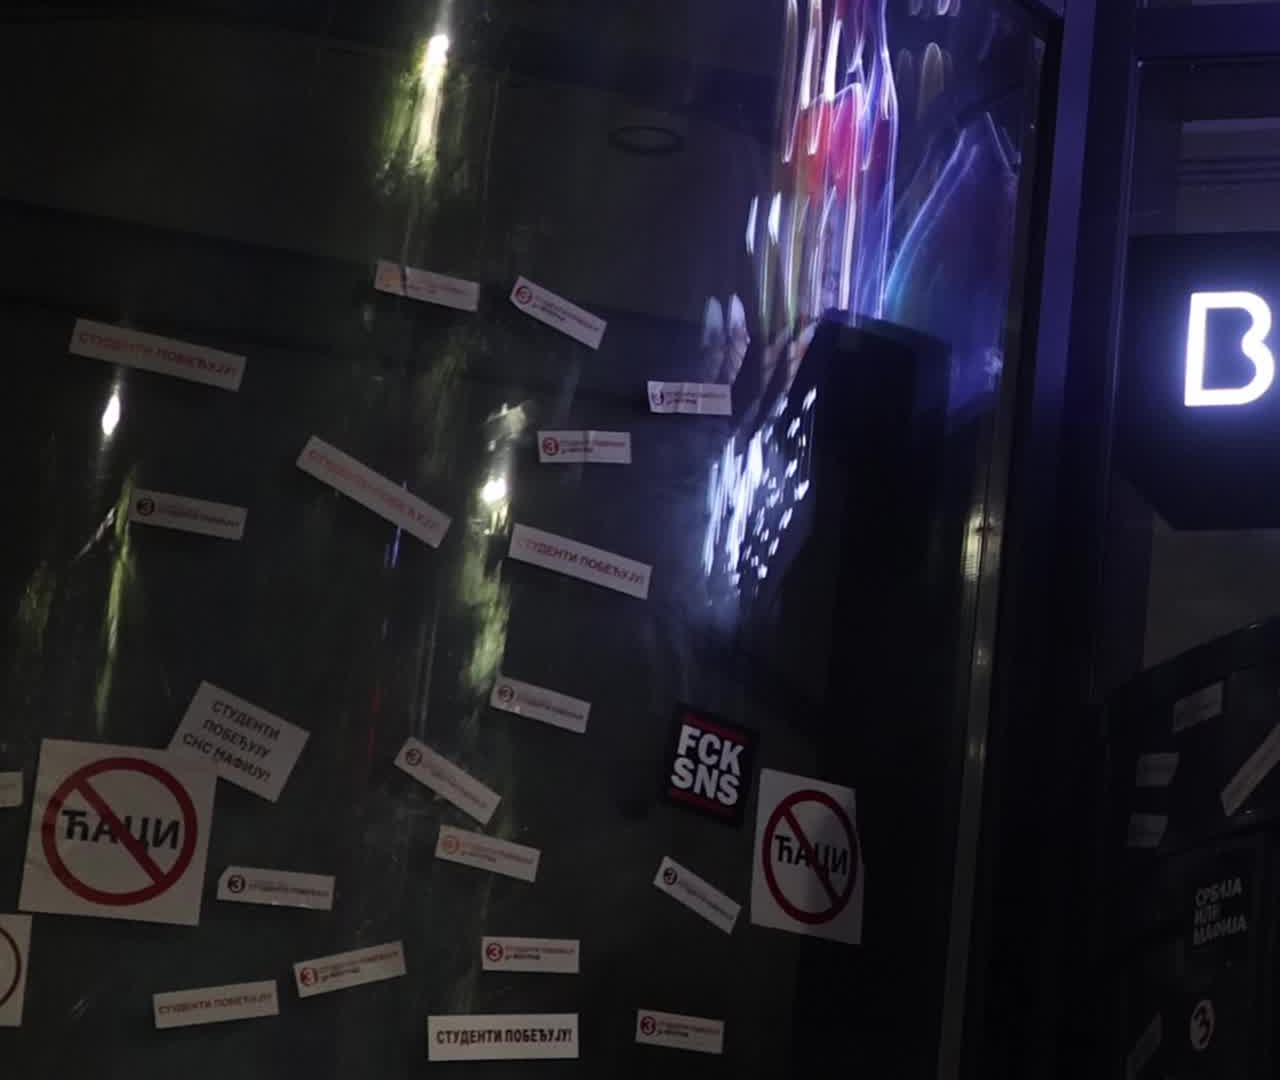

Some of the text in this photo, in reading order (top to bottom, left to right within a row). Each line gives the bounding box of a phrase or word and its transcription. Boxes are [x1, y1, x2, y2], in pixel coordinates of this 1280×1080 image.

[676, 723, 745, 775] FCK
[670, 757, 741, 808] SNS
[61, 809, 180, 851] ЋАЦИ
[774, 834, 850, 877] ЋАЦИ
[436, 1028, 573, 1046] СТУДЕНТИ ПОБЕЂУЈУ!
